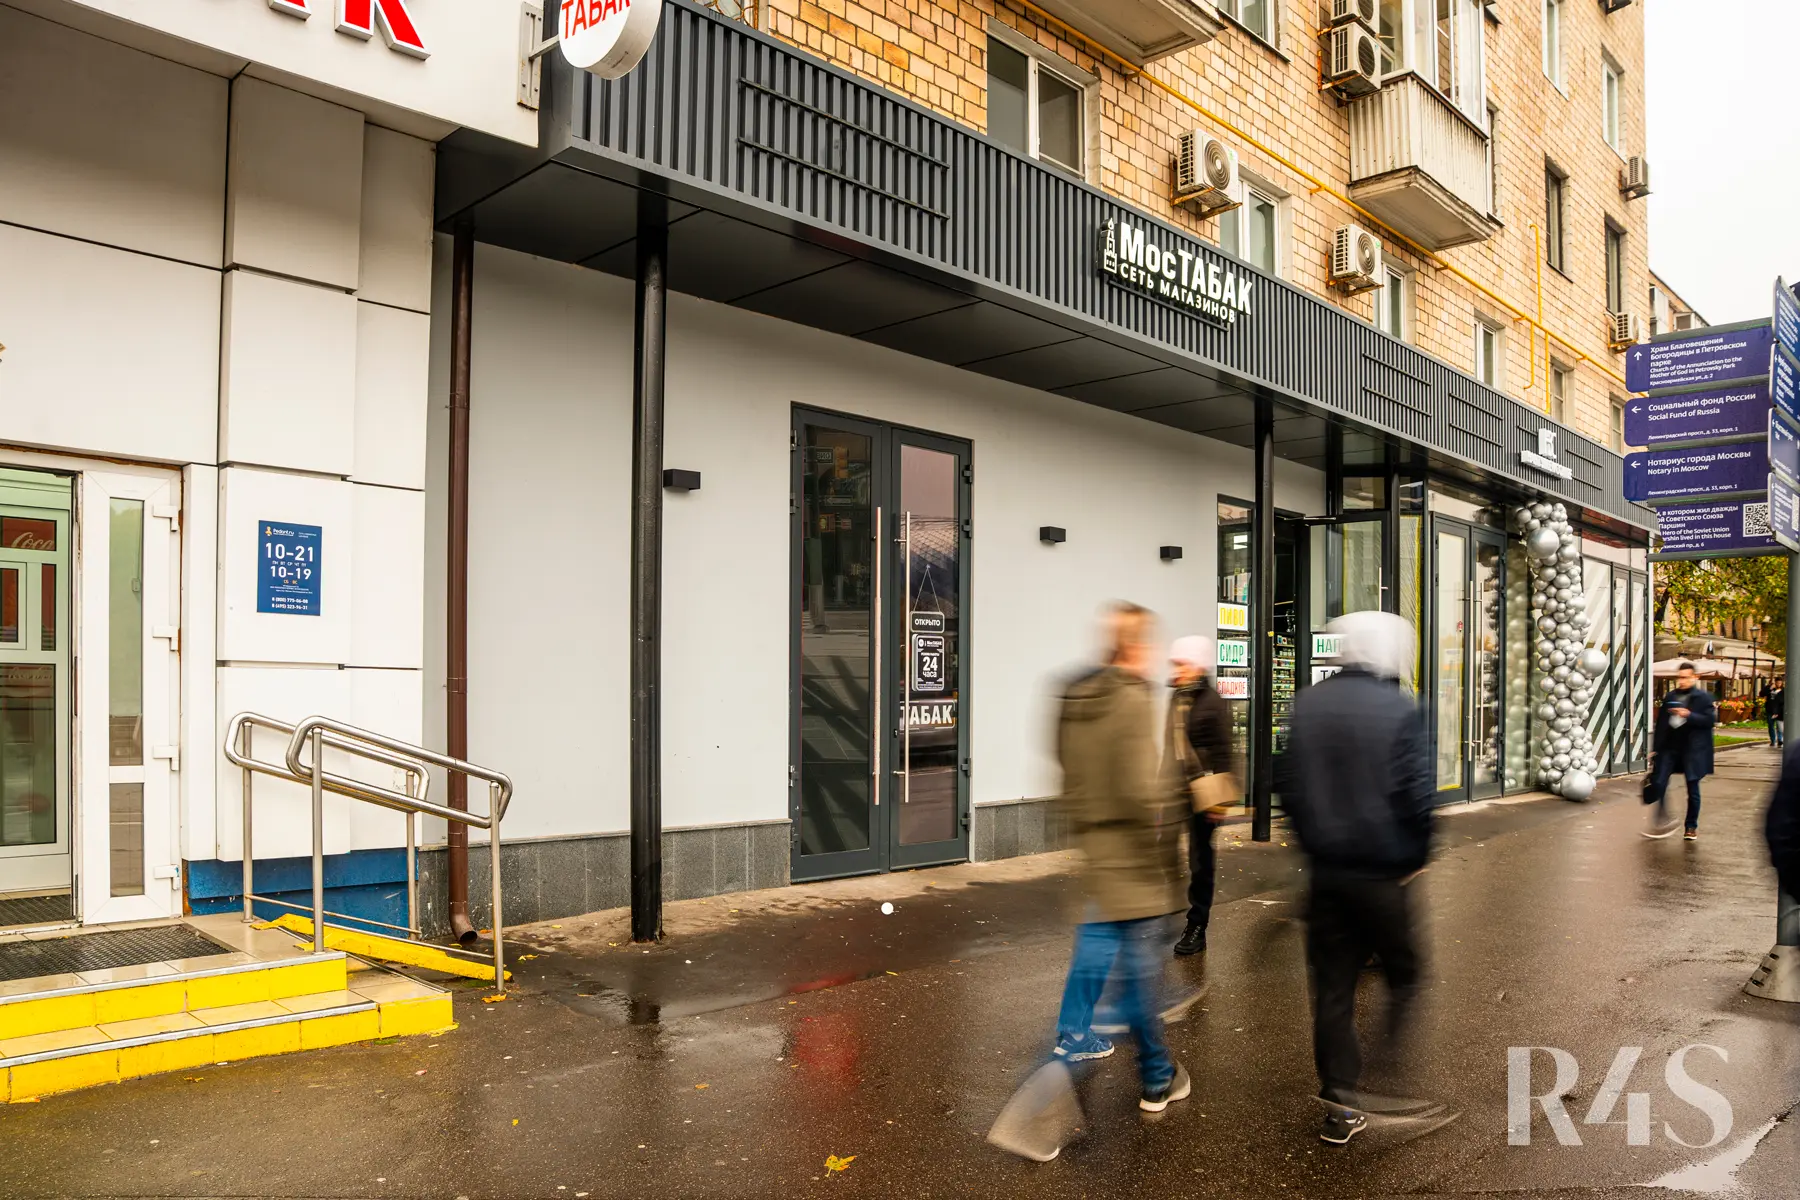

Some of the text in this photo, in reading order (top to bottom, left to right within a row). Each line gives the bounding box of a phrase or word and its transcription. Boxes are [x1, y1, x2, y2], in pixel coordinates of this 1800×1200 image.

[1119, 263, 1154, 289] СЕТЬ
[1120, 221, 1253, 316] МосТАБАК
[1160, 279, 1235, 323] МАГАЗИНОВ
[1650, 346, 1669, 354] Храм
[1650, 350, 1694, 360] Богородицы
[1702, 342, 1747, 353] Петровском
[1686, 359, 1724, 368] Annunciation
[1650, 371, 1670, 379] Mother
[1695, 365, 1722, 373] Petrovsky
[1648, 393, 1756, 411] Социальный фонд России
[1648, 413, 1668, 421] Social
[1669, 411, 1687, 419] Fund
[1697, 407, 1720, 416] Russia
[1648, 451, 1751, 466] Нотариус города Москвы
[1648, 467, 1671, 475] Notary
[1681, 464, 1709, 472] Moscow
[1668, 508, 1695, 516] котором
[1712, 506, 1738, 514] дважды
[1666, 515, 1702, 523] Советского
[266, 542, 314, 562] 10-21
[270, 566, 312, 580] 10-19
[1220, 608, 1245, 626] ПИВО
[1220, 644, 1243, 664] СИДР
[923, 656, 938, 671] 24
